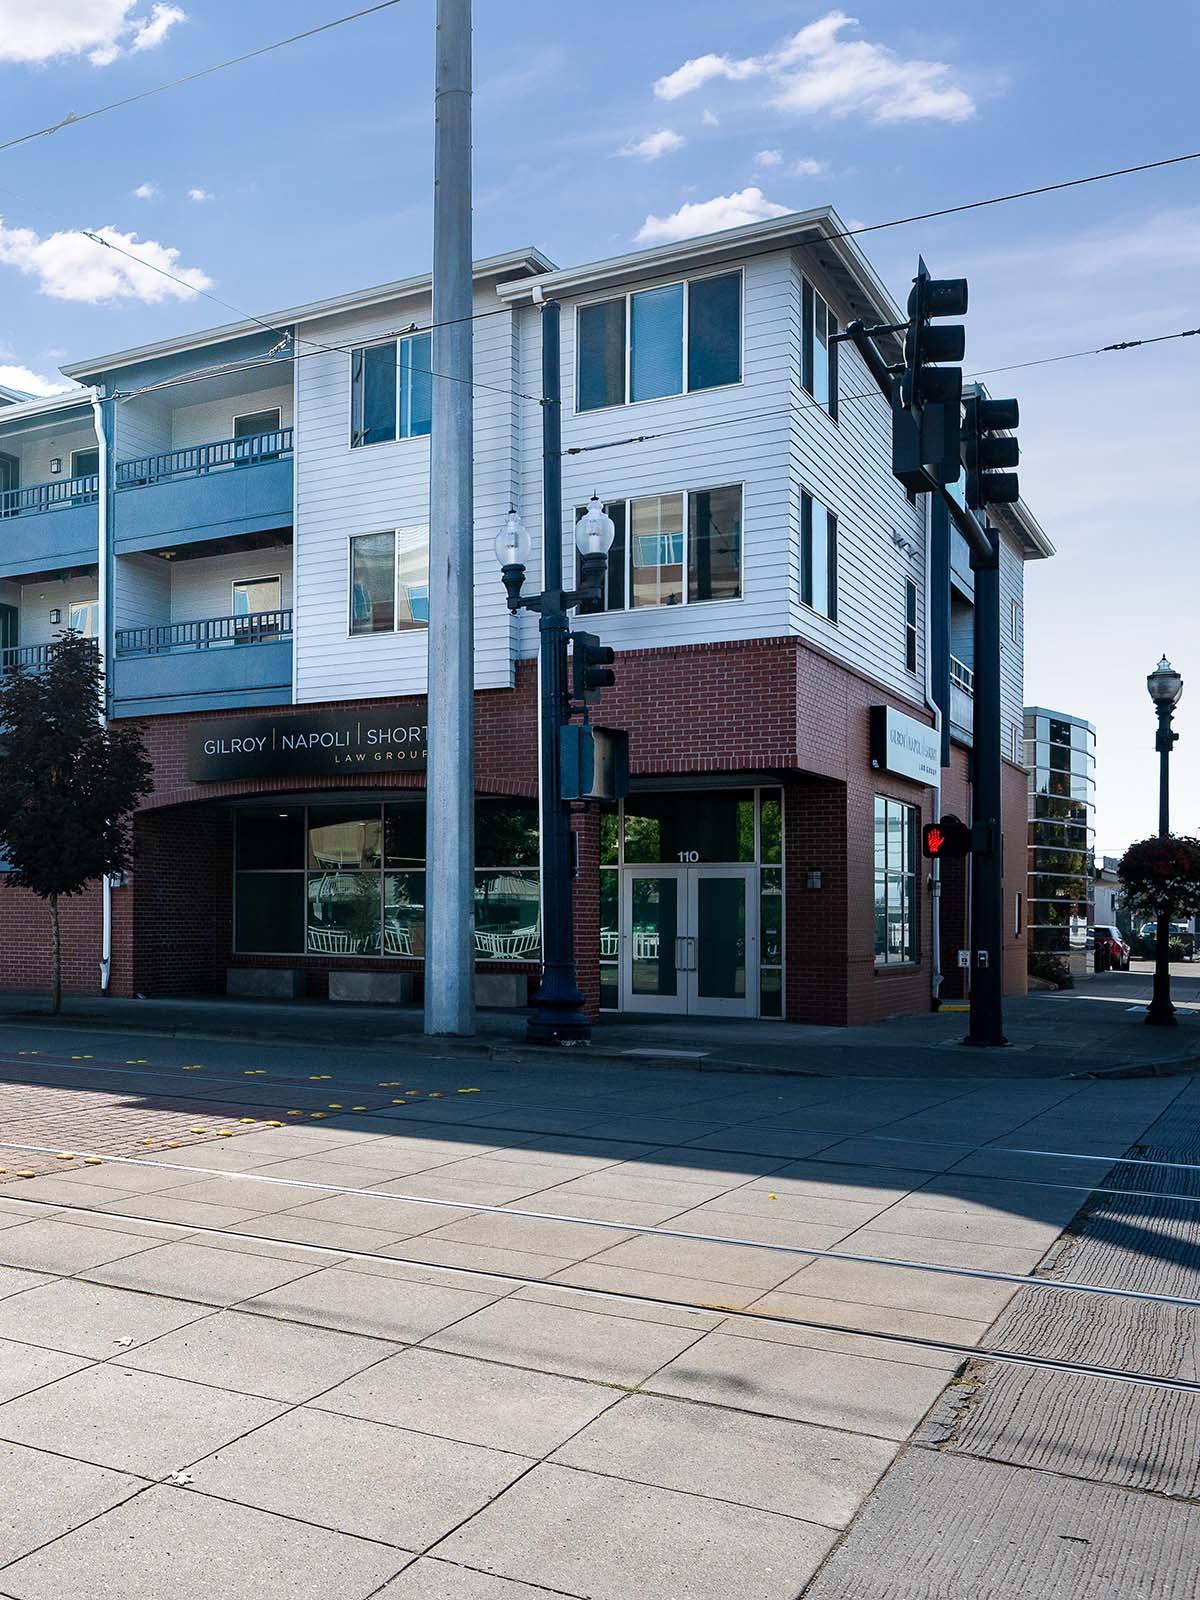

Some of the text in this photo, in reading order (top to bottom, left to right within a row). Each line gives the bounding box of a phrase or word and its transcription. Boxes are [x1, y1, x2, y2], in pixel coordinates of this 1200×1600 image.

[204, 736, 266, 754] GILROY
[282, 731, 350, 750] NAPOLI
[335, 753, 366, 763] LAW
[677, 850, 700, 863] 110
